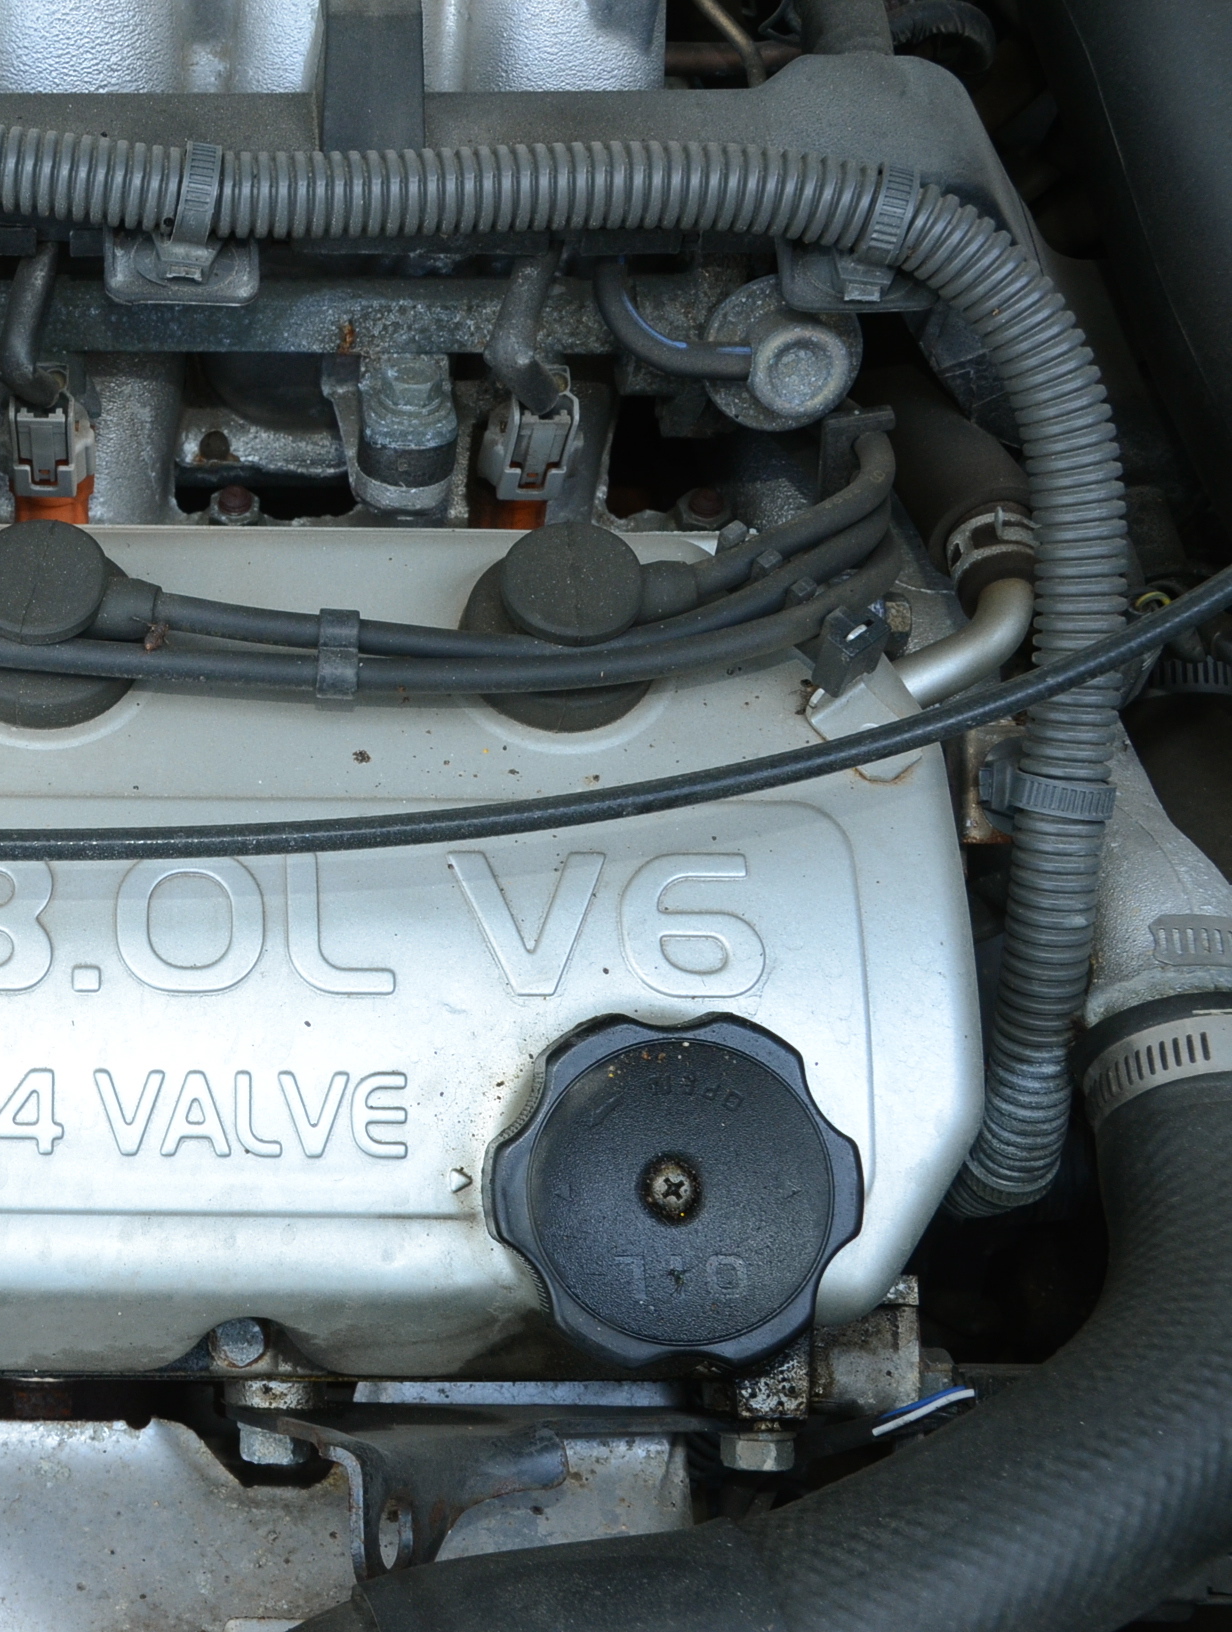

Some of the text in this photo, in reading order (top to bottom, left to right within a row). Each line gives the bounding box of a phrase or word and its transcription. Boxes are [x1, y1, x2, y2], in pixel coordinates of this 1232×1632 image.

[446, 850, 766, 998] V6
[93, 1069, 408, 1159] VALVE
[647, 1072, 745, 1112] OPEN
[613, 1253, 748, 1302] OIL
